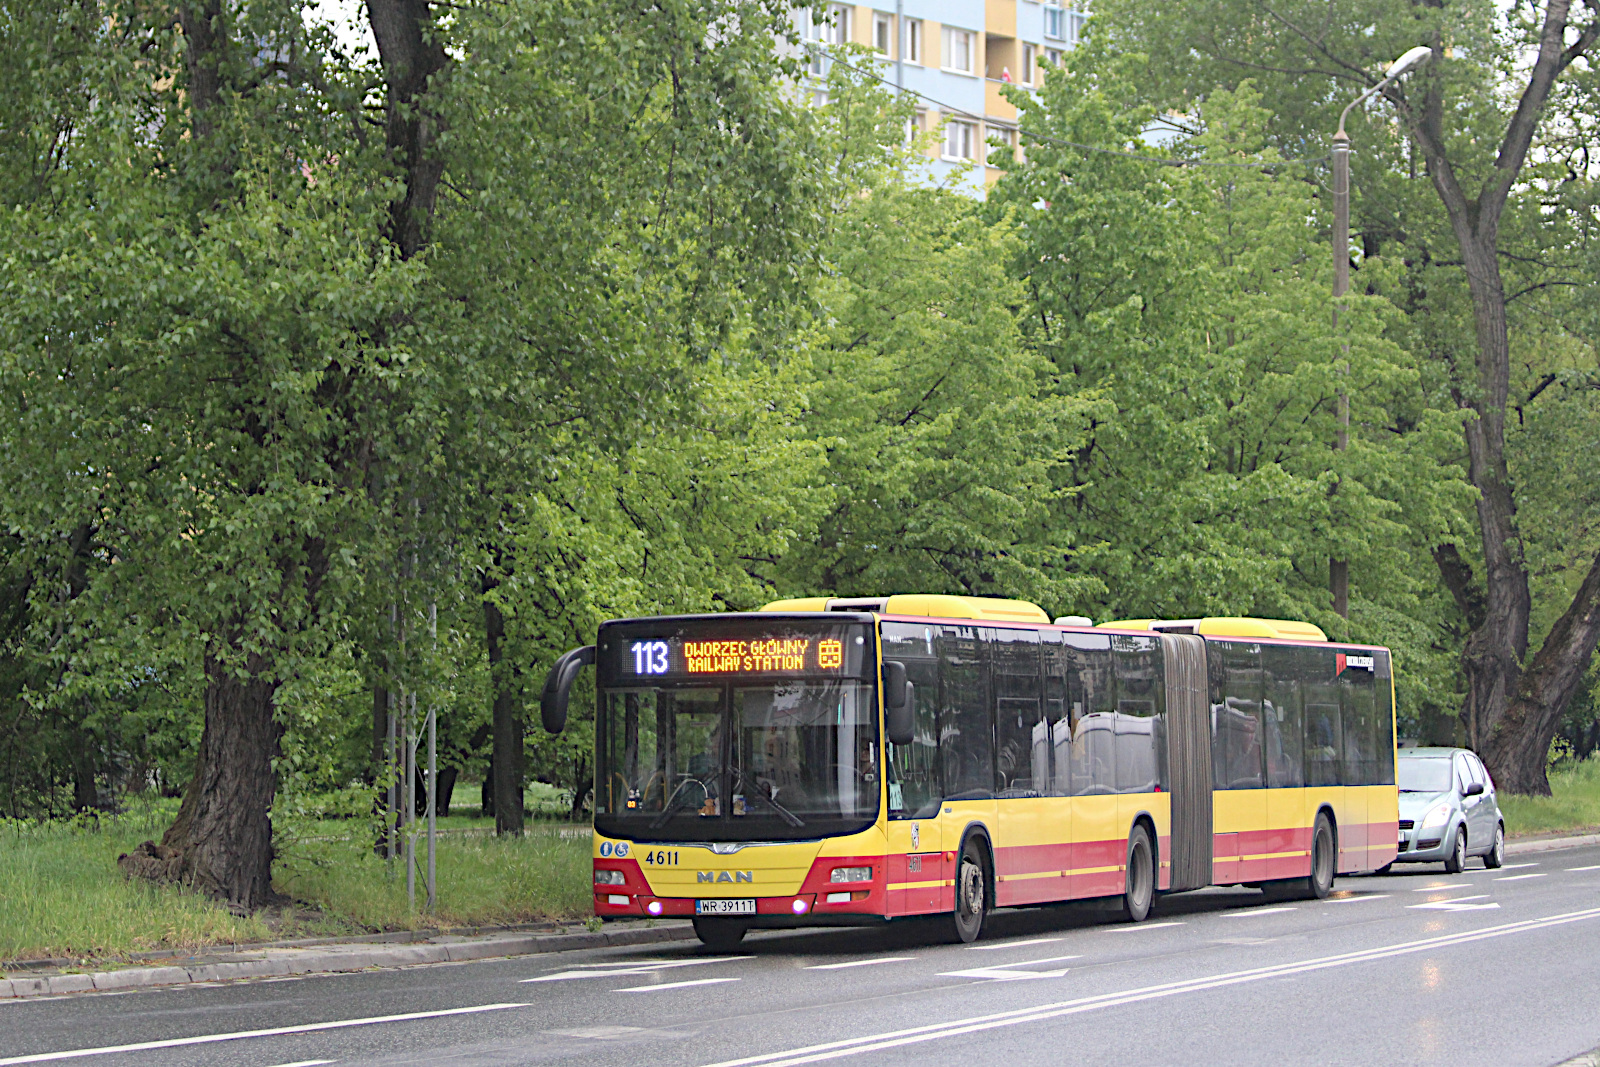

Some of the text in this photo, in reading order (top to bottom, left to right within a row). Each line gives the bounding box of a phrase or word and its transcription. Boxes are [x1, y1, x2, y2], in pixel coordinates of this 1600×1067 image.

[684, 638, 809, 658] DWORZEC GŁÓWNY
[631, 641, 669, 674] 113
[688, 654, 804, 673] RAILWAY STATION
[645, 850, 680, 866] 4611
[908, 855, 922, 873] 4611
[696, 870, 753, 883] MAN
[702, 900, 717, 912] WR
[721, 900, 754, 912] 3911T
